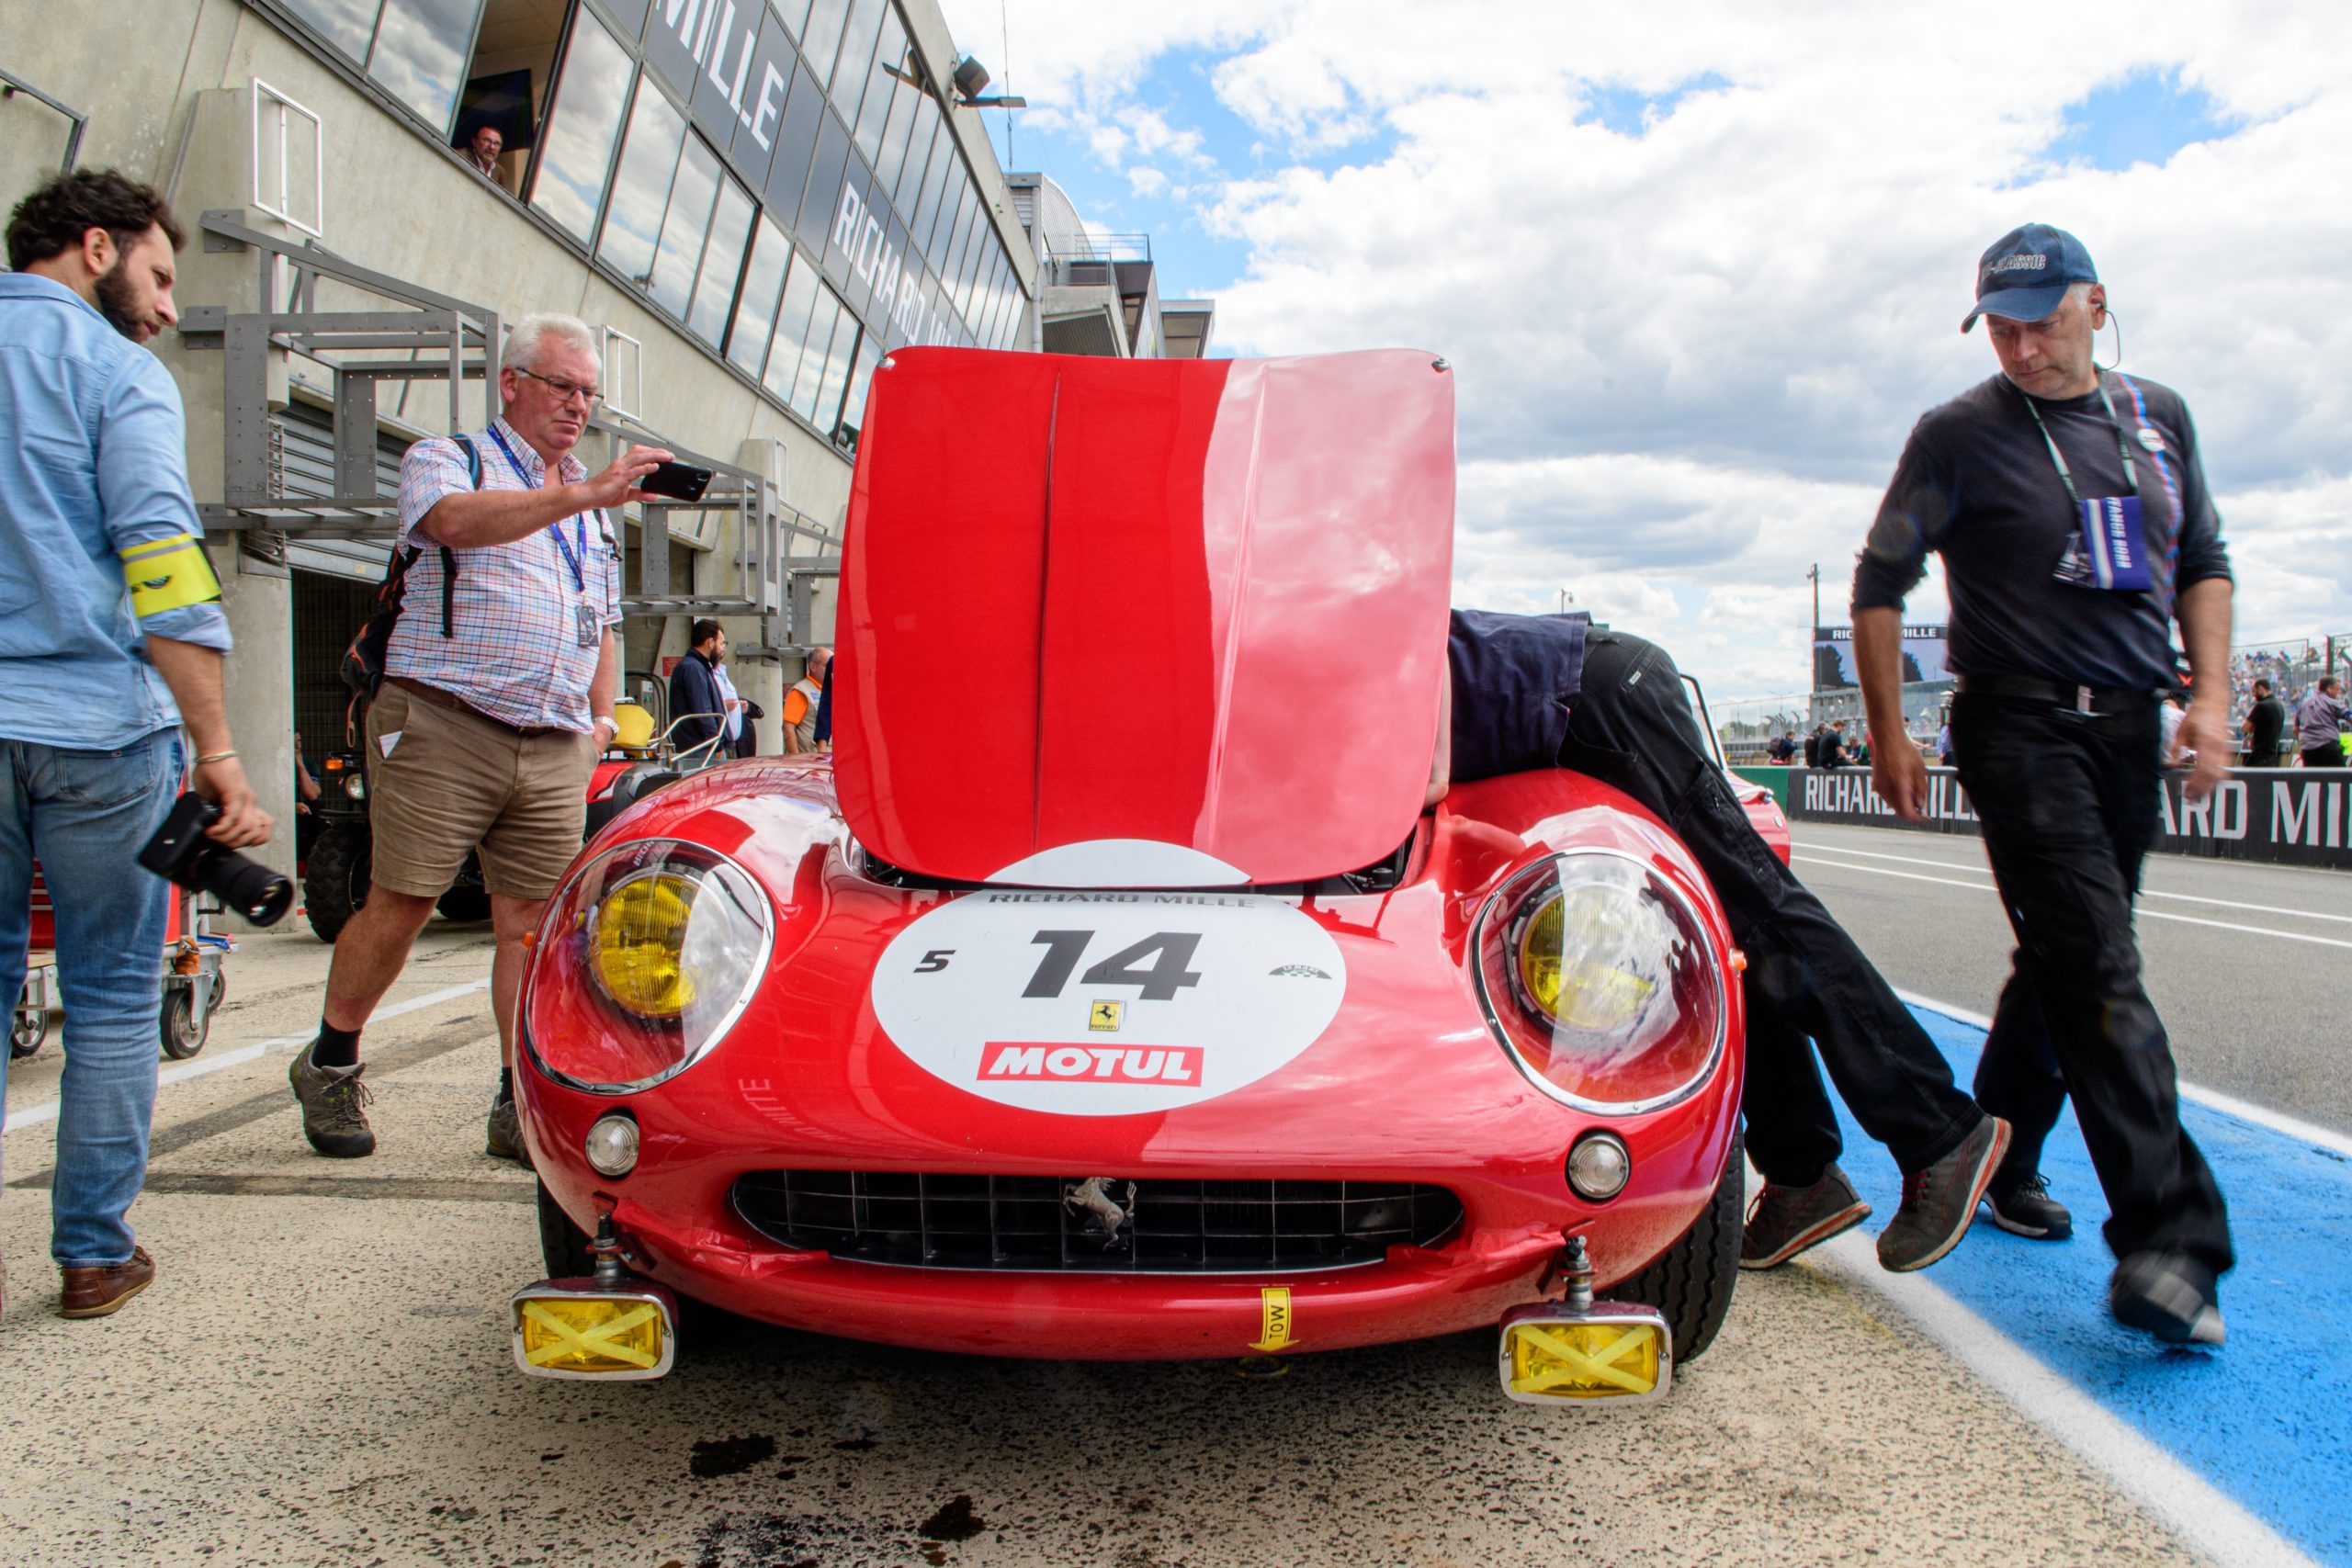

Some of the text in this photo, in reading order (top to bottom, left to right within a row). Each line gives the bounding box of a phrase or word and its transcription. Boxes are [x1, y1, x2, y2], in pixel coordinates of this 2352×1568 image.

[833, 180, 926, 346] RICHARD
[989, 893, 1256, 908] RICHARD MILLE
[913, 949, 956, 973] 5
[1021, 930, 1203, 1000] 14
[988, 1047, 1193, 1080] MOTUL
[1270, 1305, 1284, 1339] TOW
